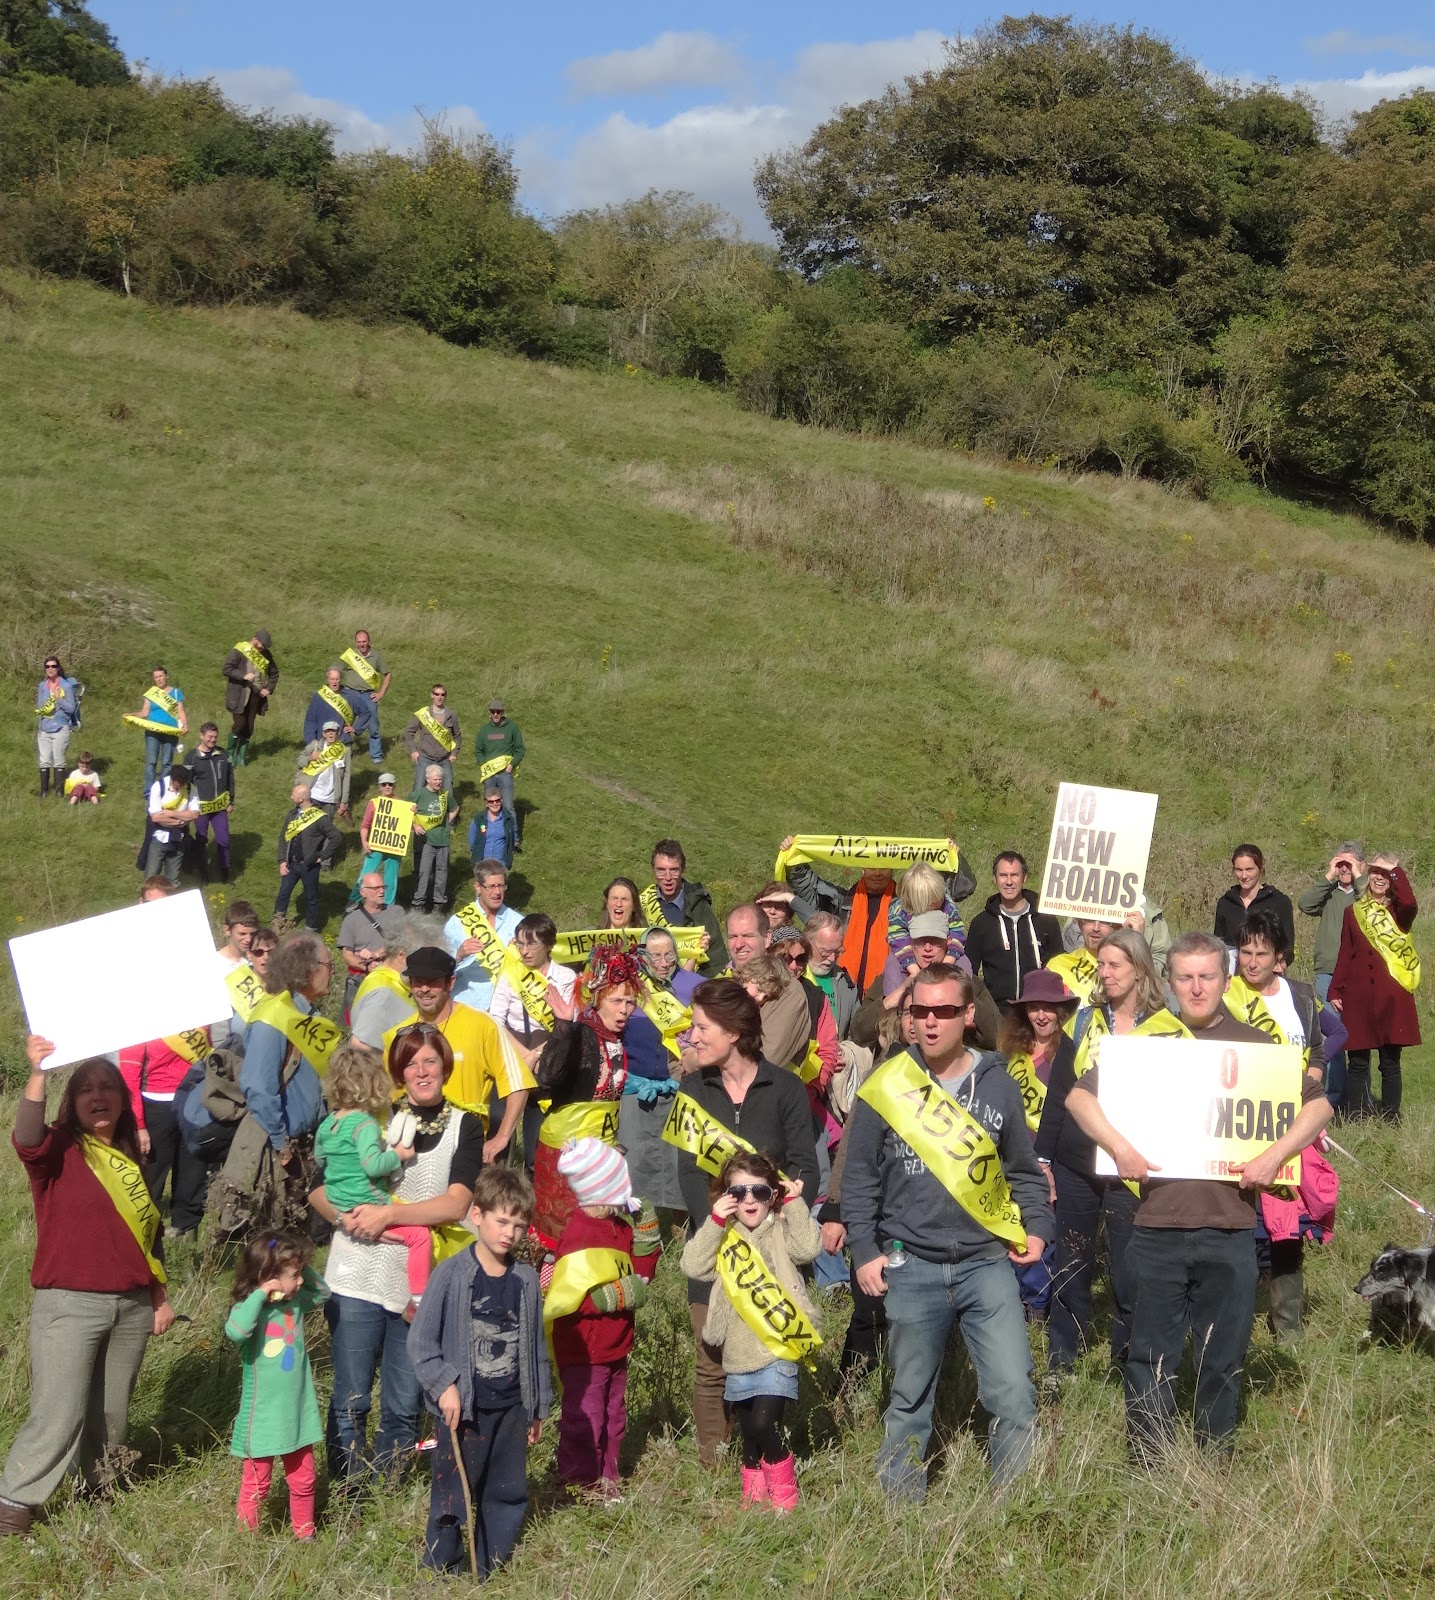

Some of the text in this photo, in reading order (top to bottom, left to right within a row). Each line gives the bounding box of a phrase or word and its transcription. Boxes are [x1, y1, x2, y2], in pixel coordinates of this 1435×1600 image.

[375, 814, 399, 831] NEW
[378, 799, 393, 814] NO
[1059, 786, 1097, 825] NO
[371, 829, 406, 849] ROADS
[830, 835, 949, 864] A12 WIDENING
[1053, 825, 1116, 866] NEW
[1046, 863, 1138, 908] ROADS
[295, 1016, 335, 1053] A43
[897, 1084, 996, 1185] A556
[723, 1239, 812, 1342] RUGBY
